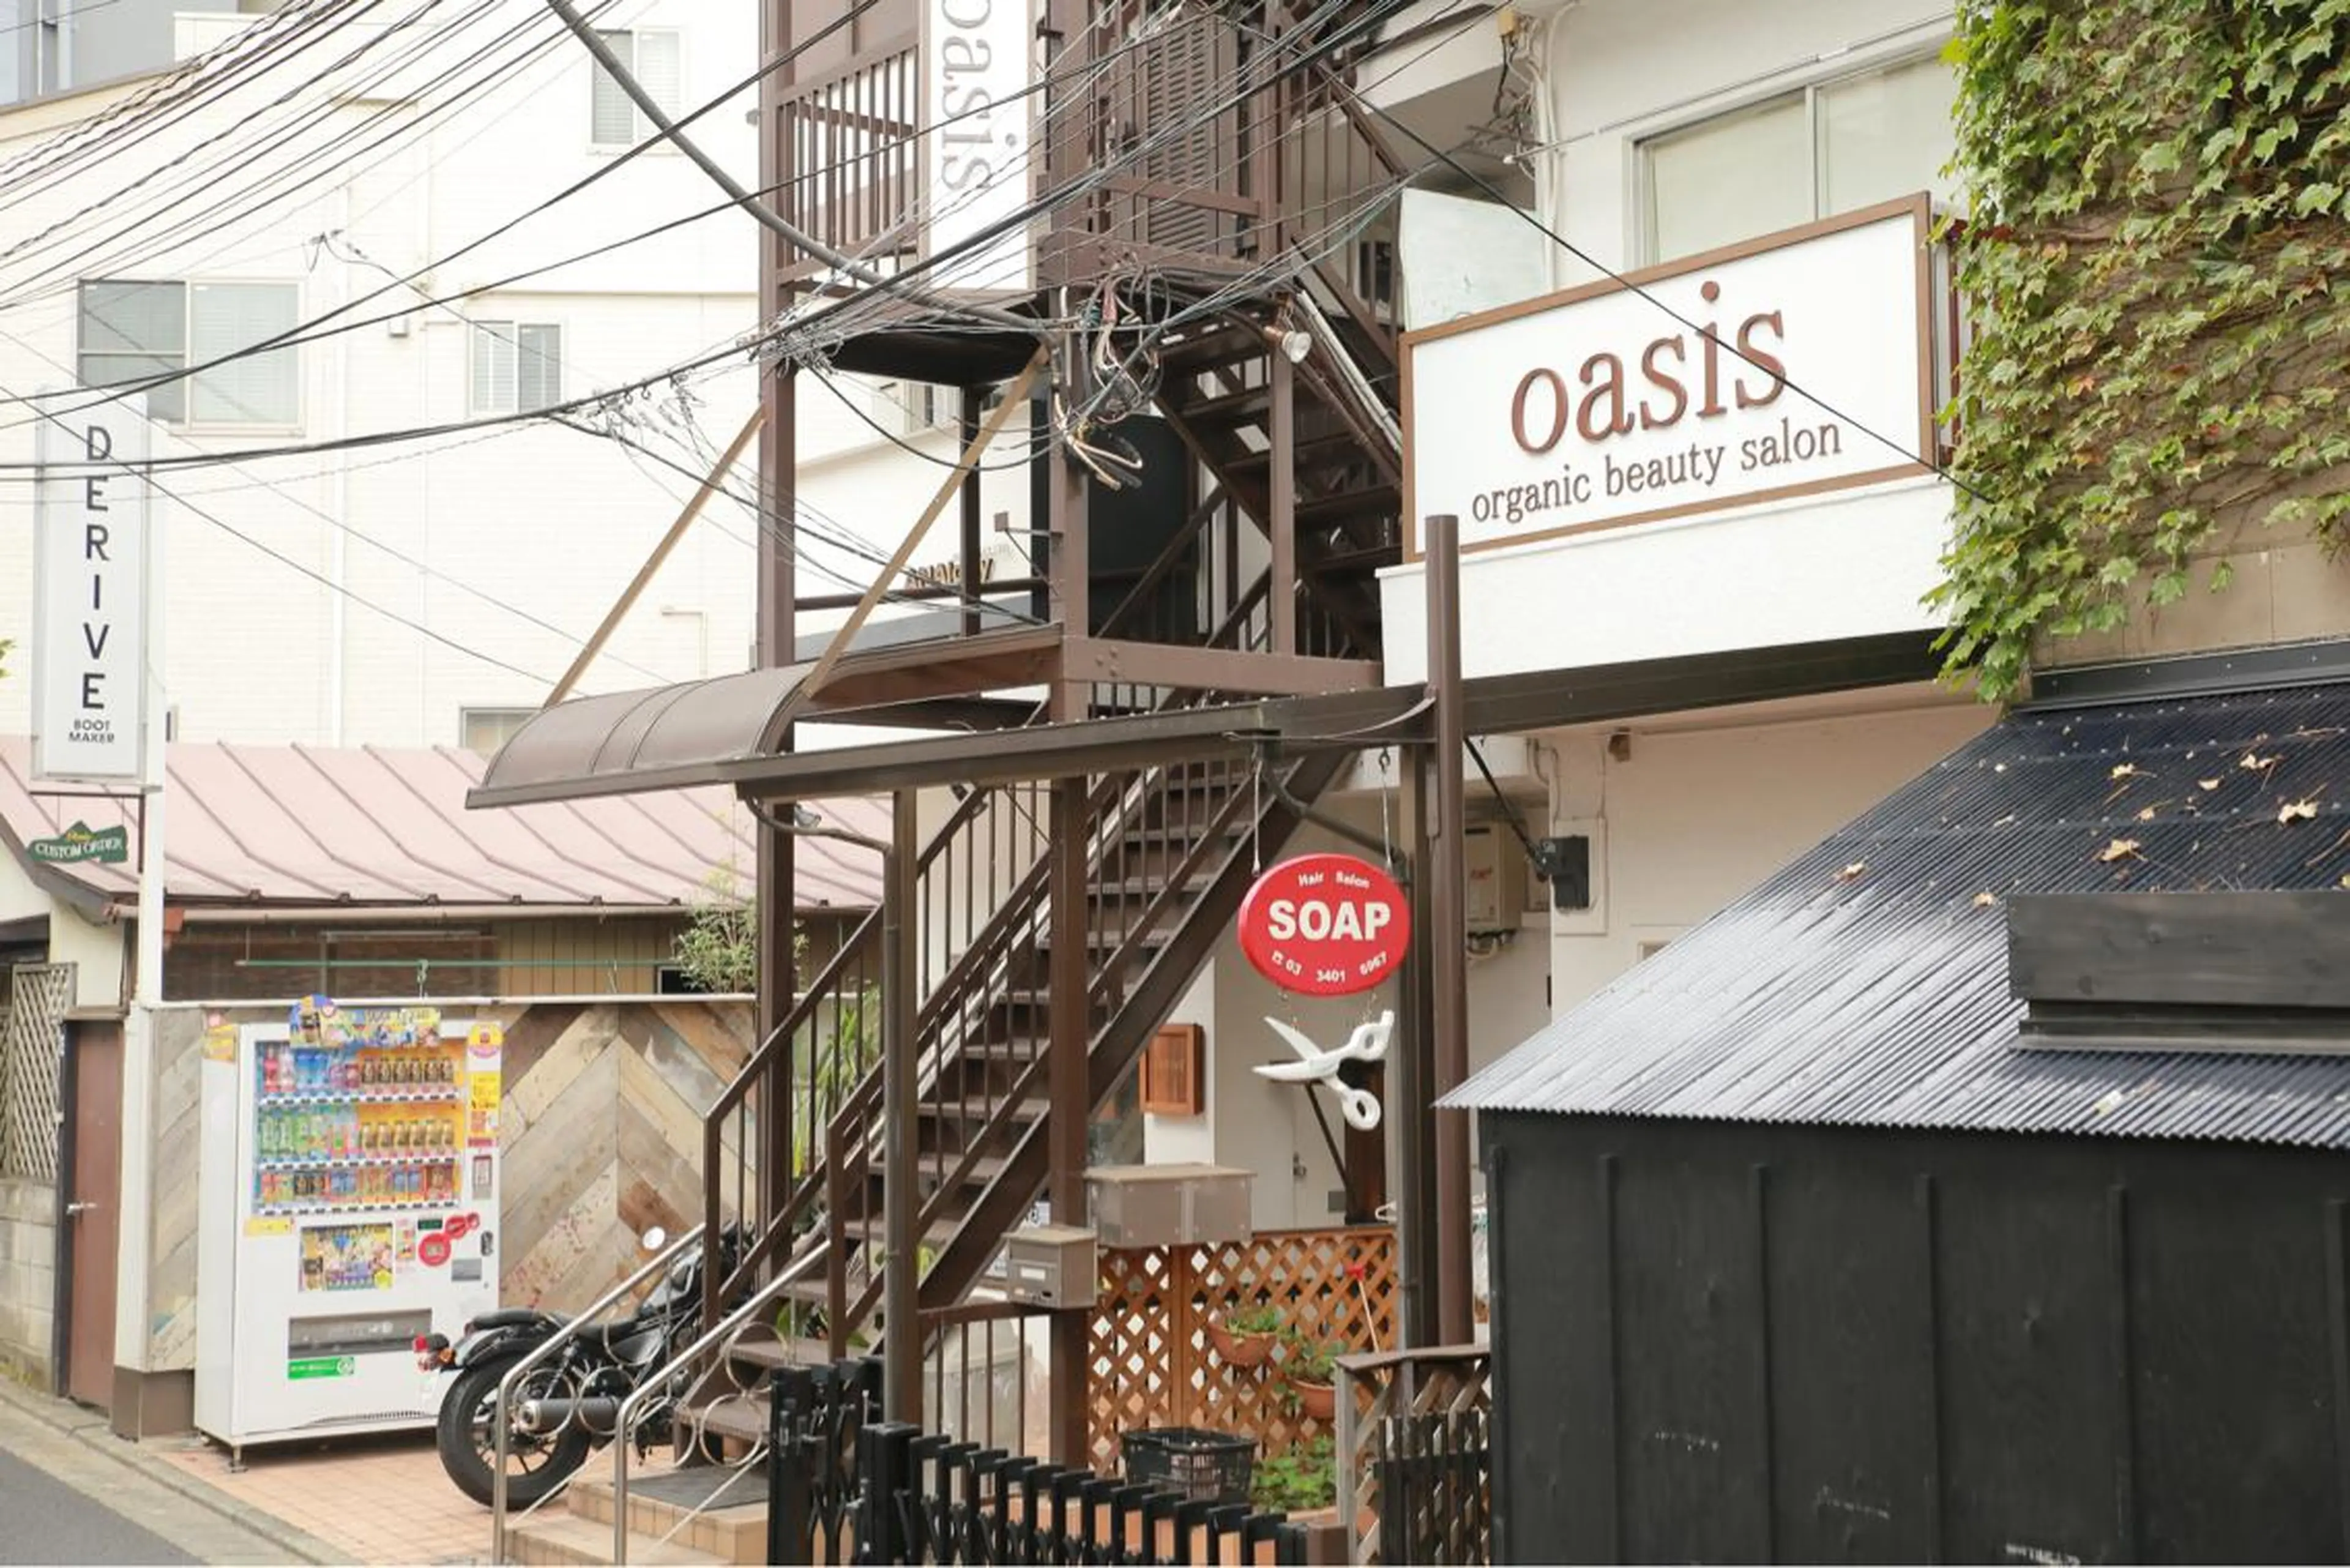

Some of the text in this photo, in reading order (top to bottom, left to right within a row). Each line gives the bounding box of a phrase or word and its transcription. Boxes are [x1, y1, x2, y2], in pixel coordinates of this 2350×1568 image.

[1510, 280, 1787, 454] oasis
[1472, 417, 1843, 524] organic beauty salon
[81, 425, 113, 710] DERIVE
[73, 718, 111, 731] BOOT
[1268, 900, 1390, 941] SOAP
